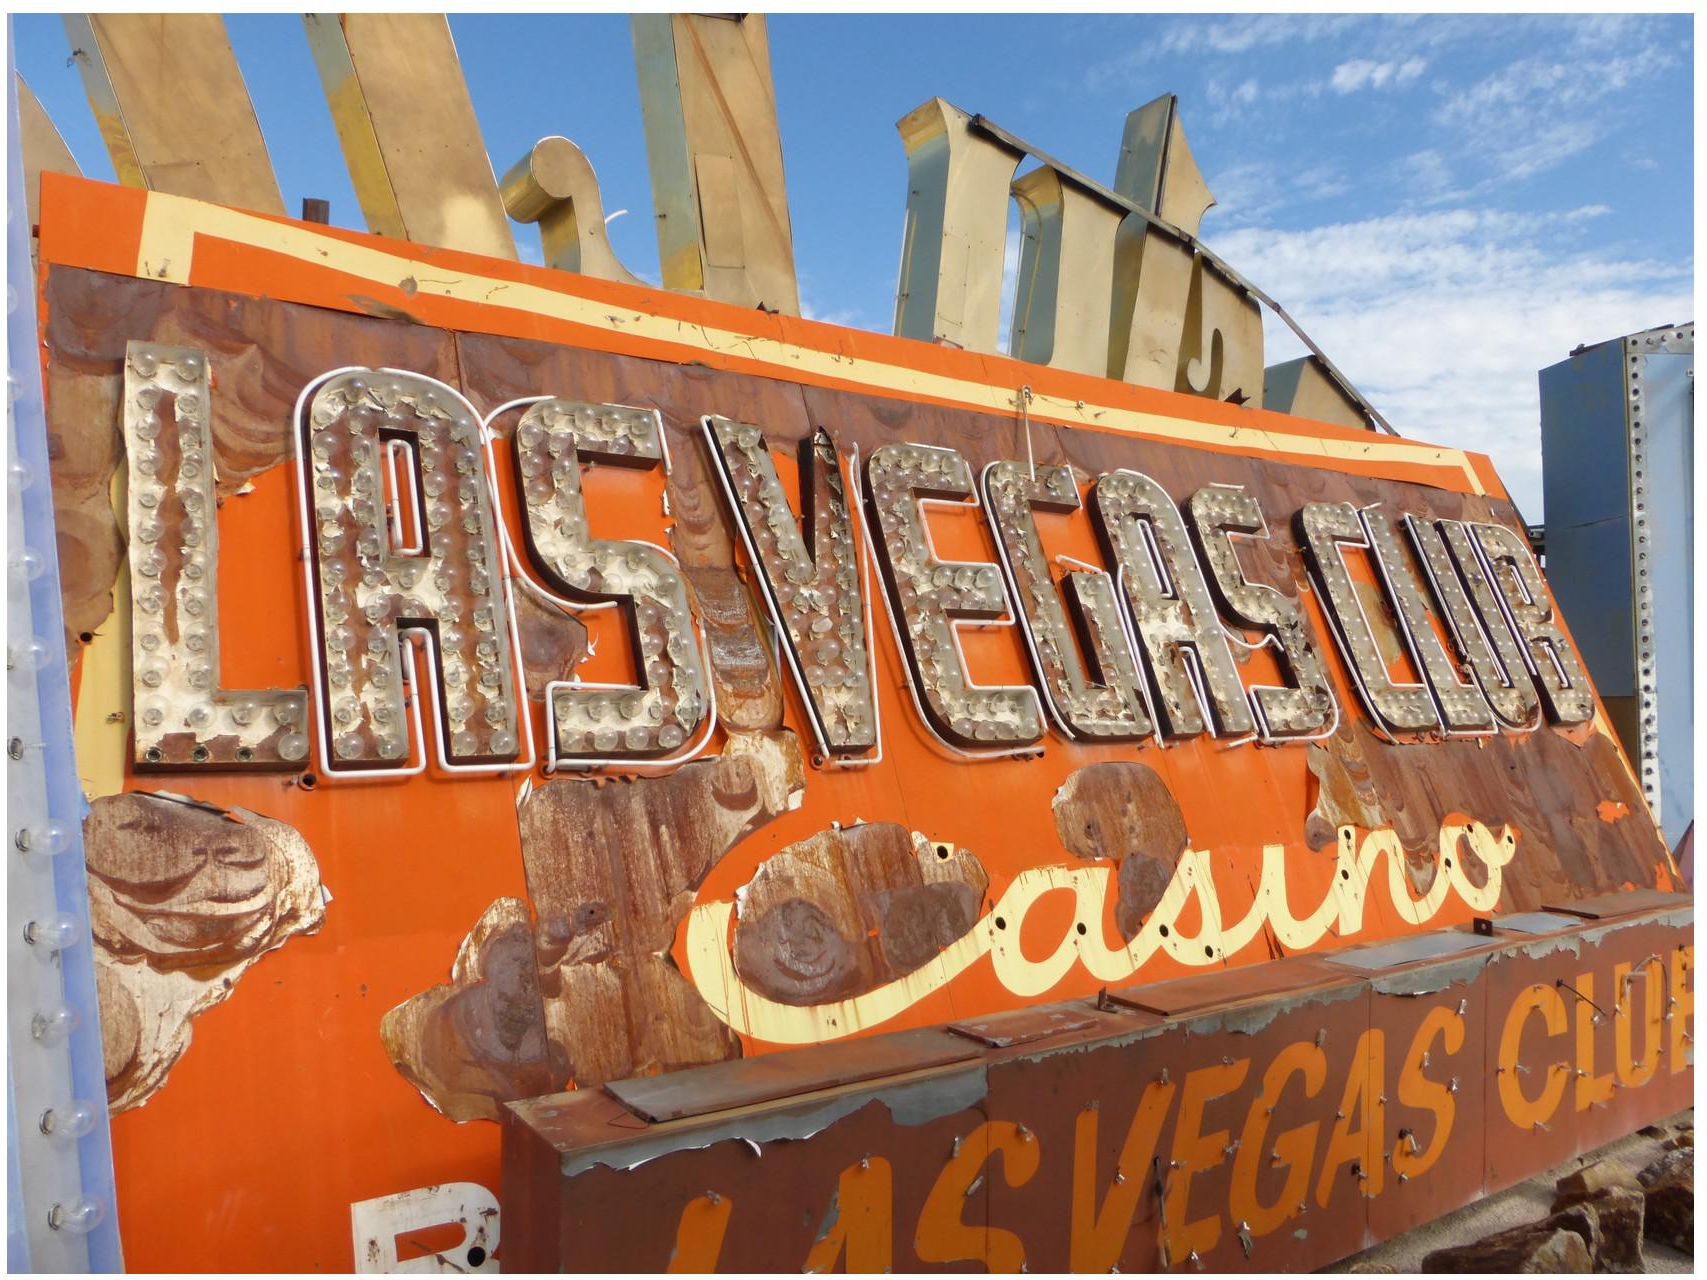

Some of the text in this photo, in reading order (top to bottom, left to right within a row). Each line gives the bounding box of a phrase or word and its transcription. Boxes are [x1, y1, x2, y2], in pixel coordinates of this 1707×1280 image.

[125, 340, 1595, 782] LAS VEGAS CLUB
[685, 817, 1517, 1046] Casino
[1070, 1006, 1465, 1274] VEGAS
